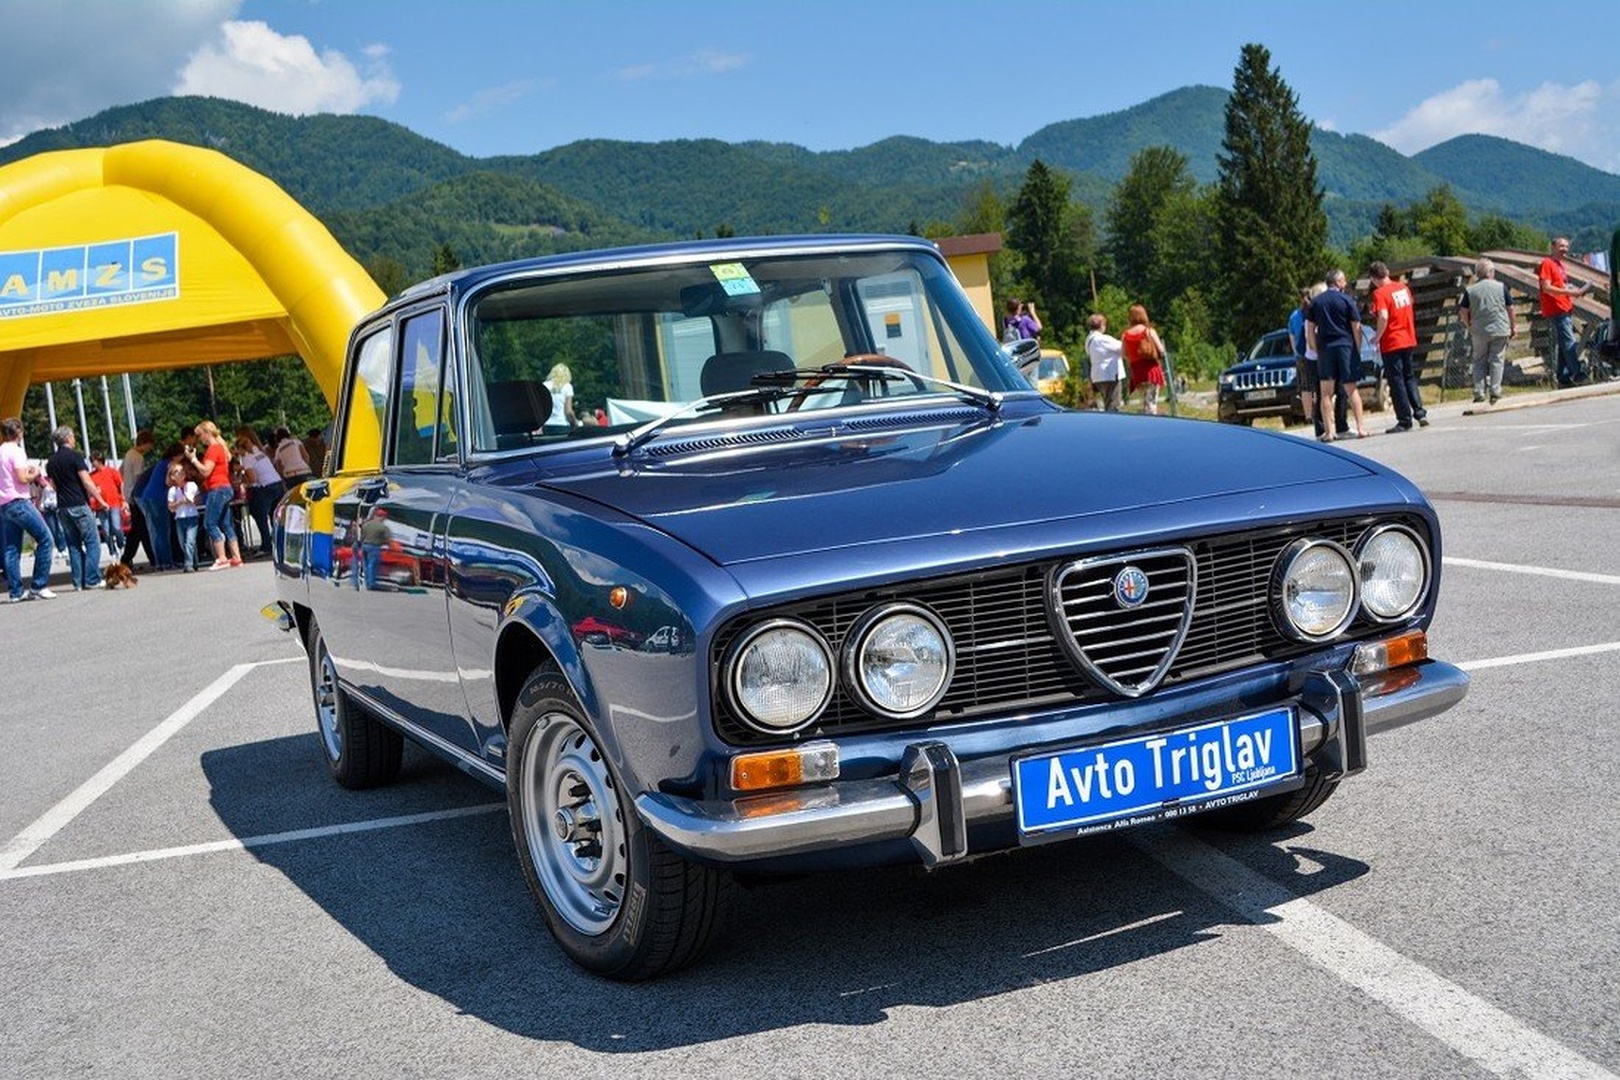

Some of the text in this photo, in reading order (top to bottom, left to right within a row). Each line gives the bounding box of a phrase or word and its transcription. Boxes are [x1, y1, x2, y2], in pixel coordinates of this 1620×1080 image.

[68, 297, 106, 309] ZVEZA
[110, 287, 175, 304] SLOVENIJE
[1047, 726, 1272, 809] Avto Triglav
[1231, 765, 1275, 784] PSC Ljubljana
[1130, 815, 1156, 825] Romeo
